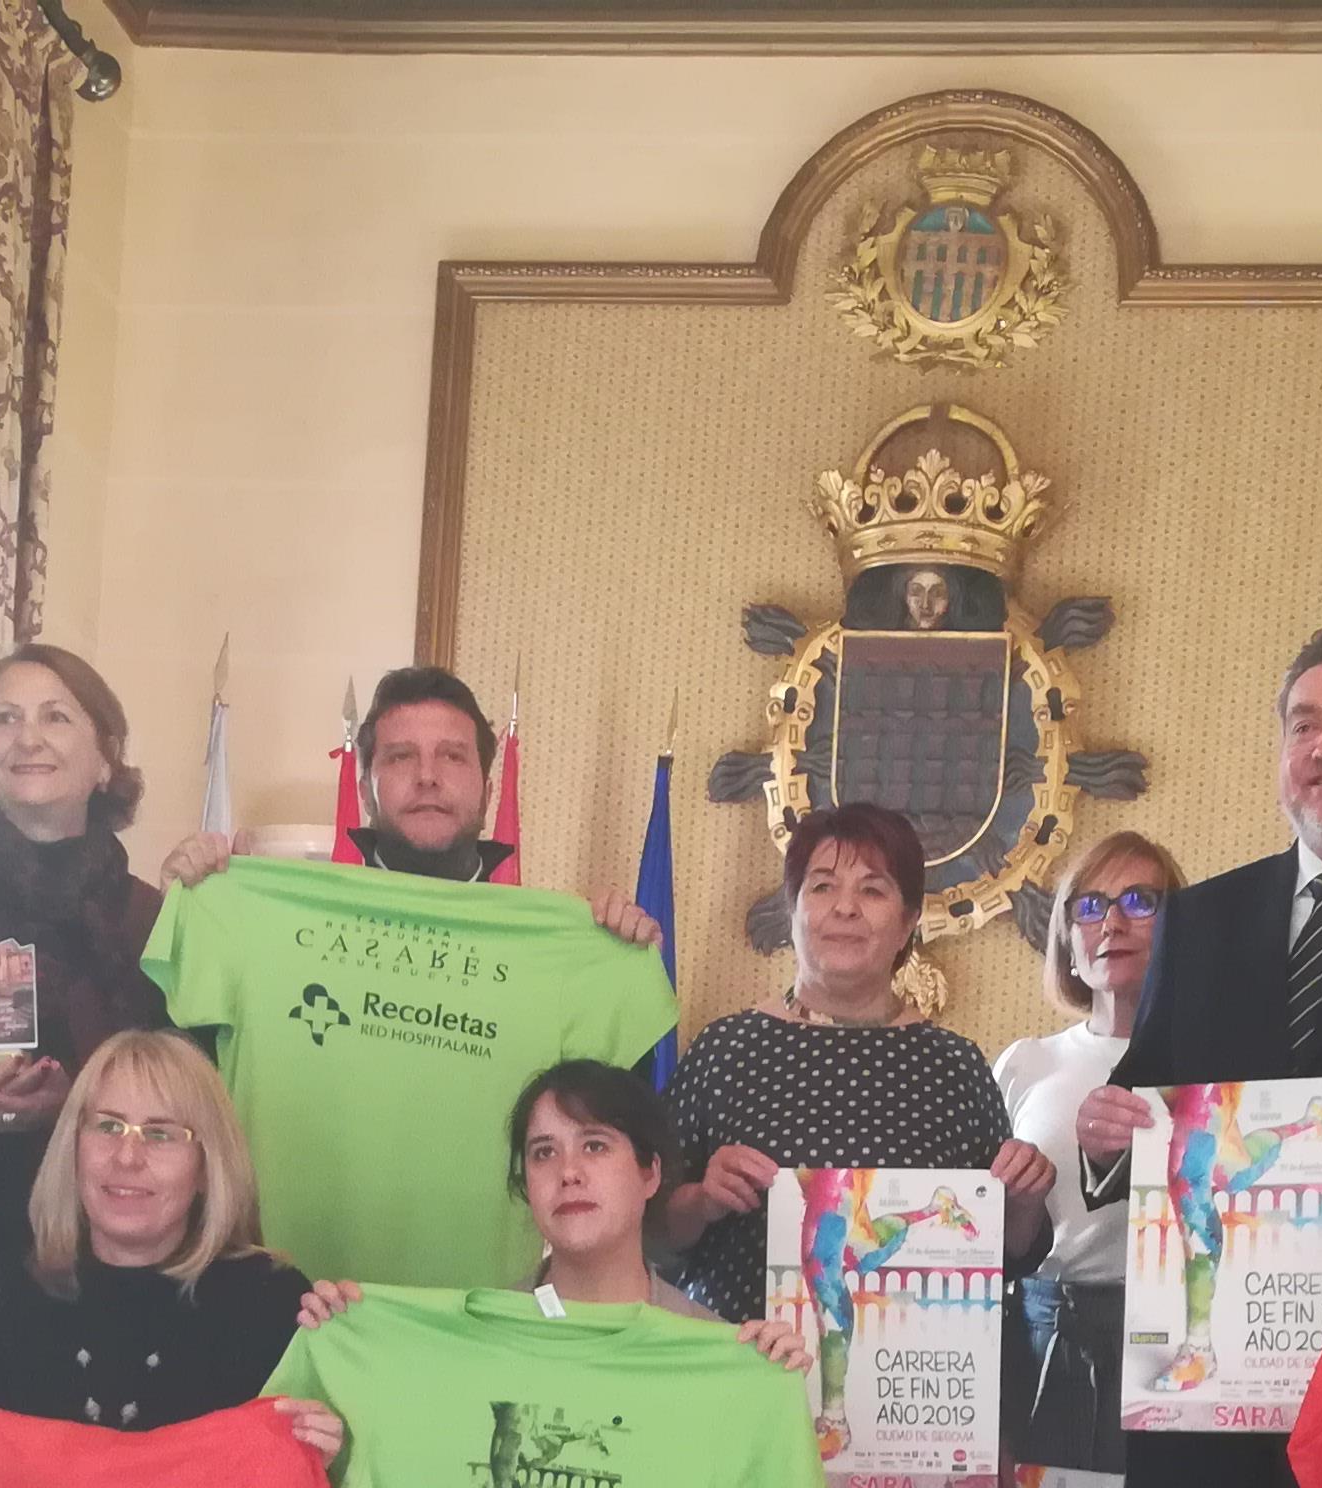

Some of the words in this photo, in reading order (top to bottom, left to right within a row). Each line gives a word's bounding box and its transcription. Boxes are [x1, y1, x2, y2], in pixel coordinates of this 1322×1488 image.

[325, 920, 477, 953] RESTAURANTE
[356, 914, 451, 938] TABERNA
[362, 991, 498, 1040] Recoletas
[360, 1023, 388, 1038] RED
[390, 1028, 492, 1059] HOSPITALARIA
[1246, 1301, 1277, 1325] DE
[1282, 1301, 1315, 1324] FIN
[1244, 1327, 1291, 1351] AÑO
[874, 1349, 976, 1374] CARRERA
[877, 1377, 905, 1399] DE
[910, 1377, 940, 1400] FIN
[947, 1377, 975, 1400] DE
[876, 1402, 919, 1426] AÑO
[923, 1404, 975, 1427] 2019
[1214, 1406, 1285, 1427] SARA
